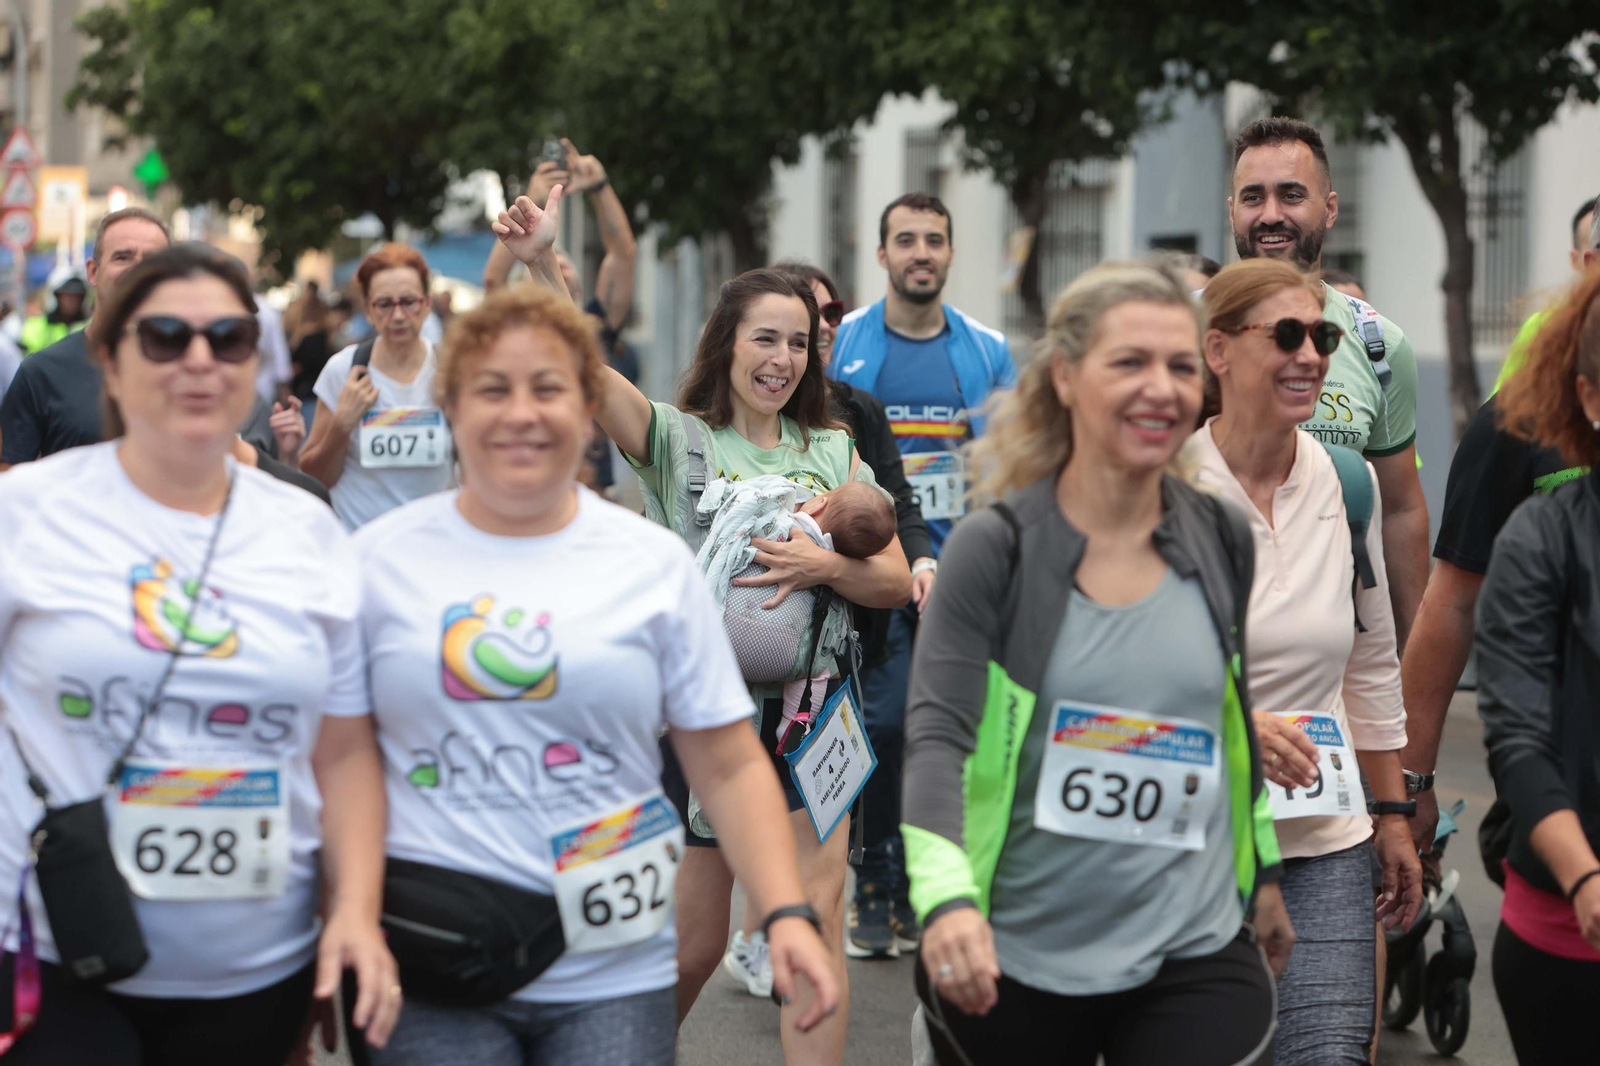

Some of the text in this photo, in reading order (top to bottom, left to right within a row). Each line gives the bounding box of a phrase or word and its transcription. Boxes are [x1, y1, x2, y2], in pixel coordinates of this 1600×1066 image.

[884, 405, 956, 420] OLICI
[1319, 392, 1353, 422] SS
[371, 434, 418, 456] 607
[911, 485, 937, 507] 51
[1296, 721, 1335, 733] OPULAR
[812, 737, 839, 777] BABYRUNNER
[828, 764, 834, 774] 4
[820, 782, 836, 806] AMELIE
[832, 780, 846, 801] PEREA
[1060, 766, 1164, 823] 630
[134, 826, 239, 876] 628
[582, 863, 665, 926] 632
